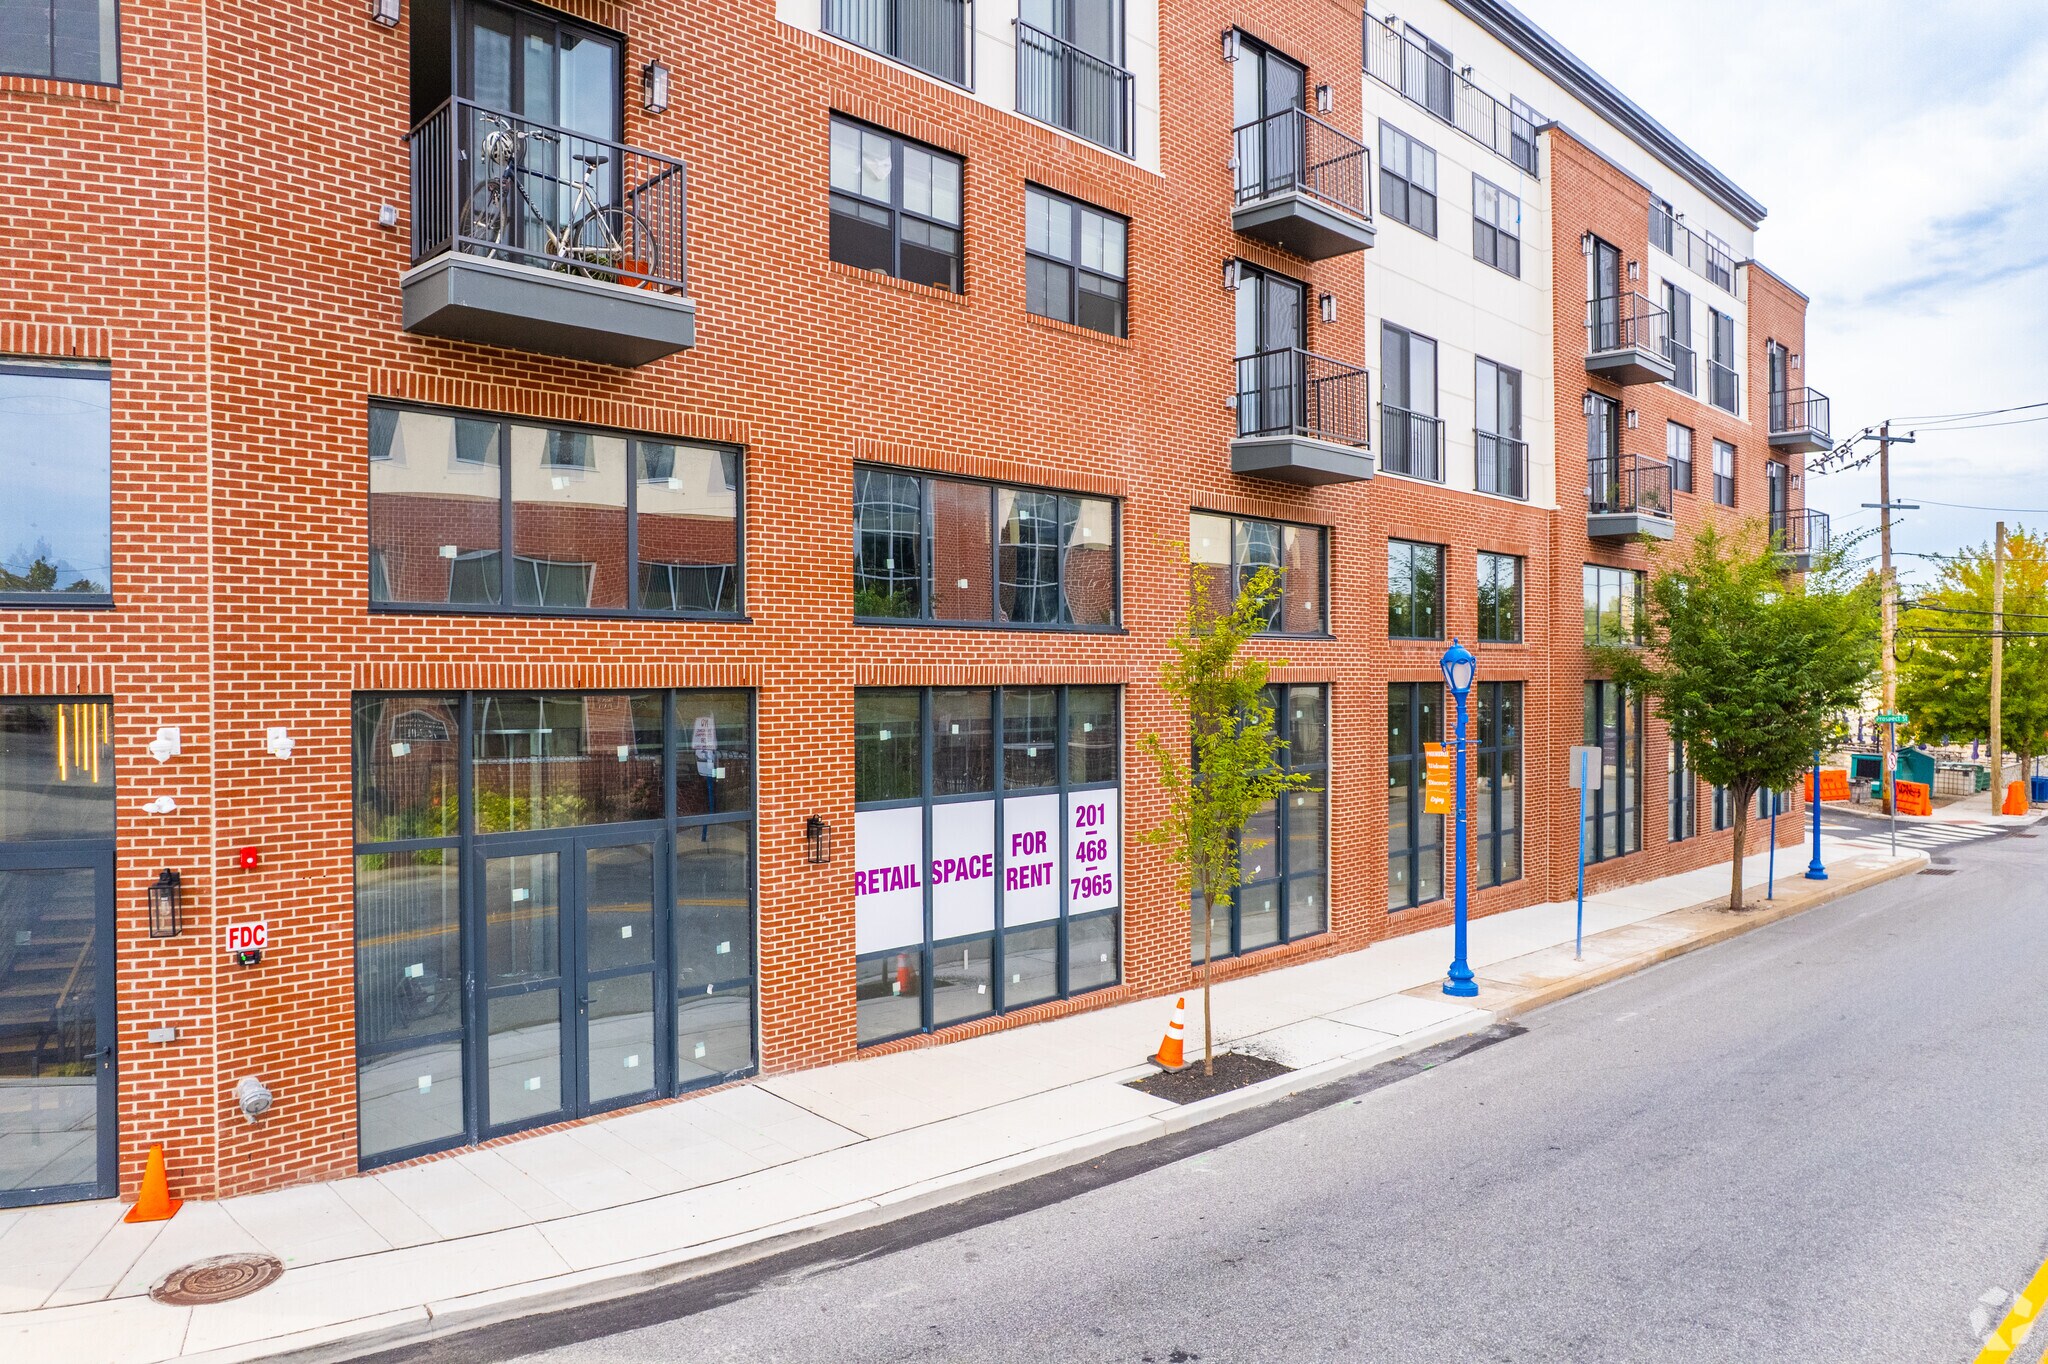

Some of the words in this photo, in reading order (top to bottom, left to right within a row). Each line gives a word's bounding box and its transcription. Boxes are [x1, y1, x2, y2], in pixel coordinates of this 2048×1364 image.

[1075, 803, 1105, 828] 201
[1011, 830, 1047, 857] FOR
[1075, 838, 1108, 864] 468
[855, 864, 921, 897] RETAIL
[932, 853, 993, 885] SPACE
[1006, 861, 1054, 892] RENT
[1070, 872, 1113, 900] 7965
[229, 924, 265, 949] FDC
